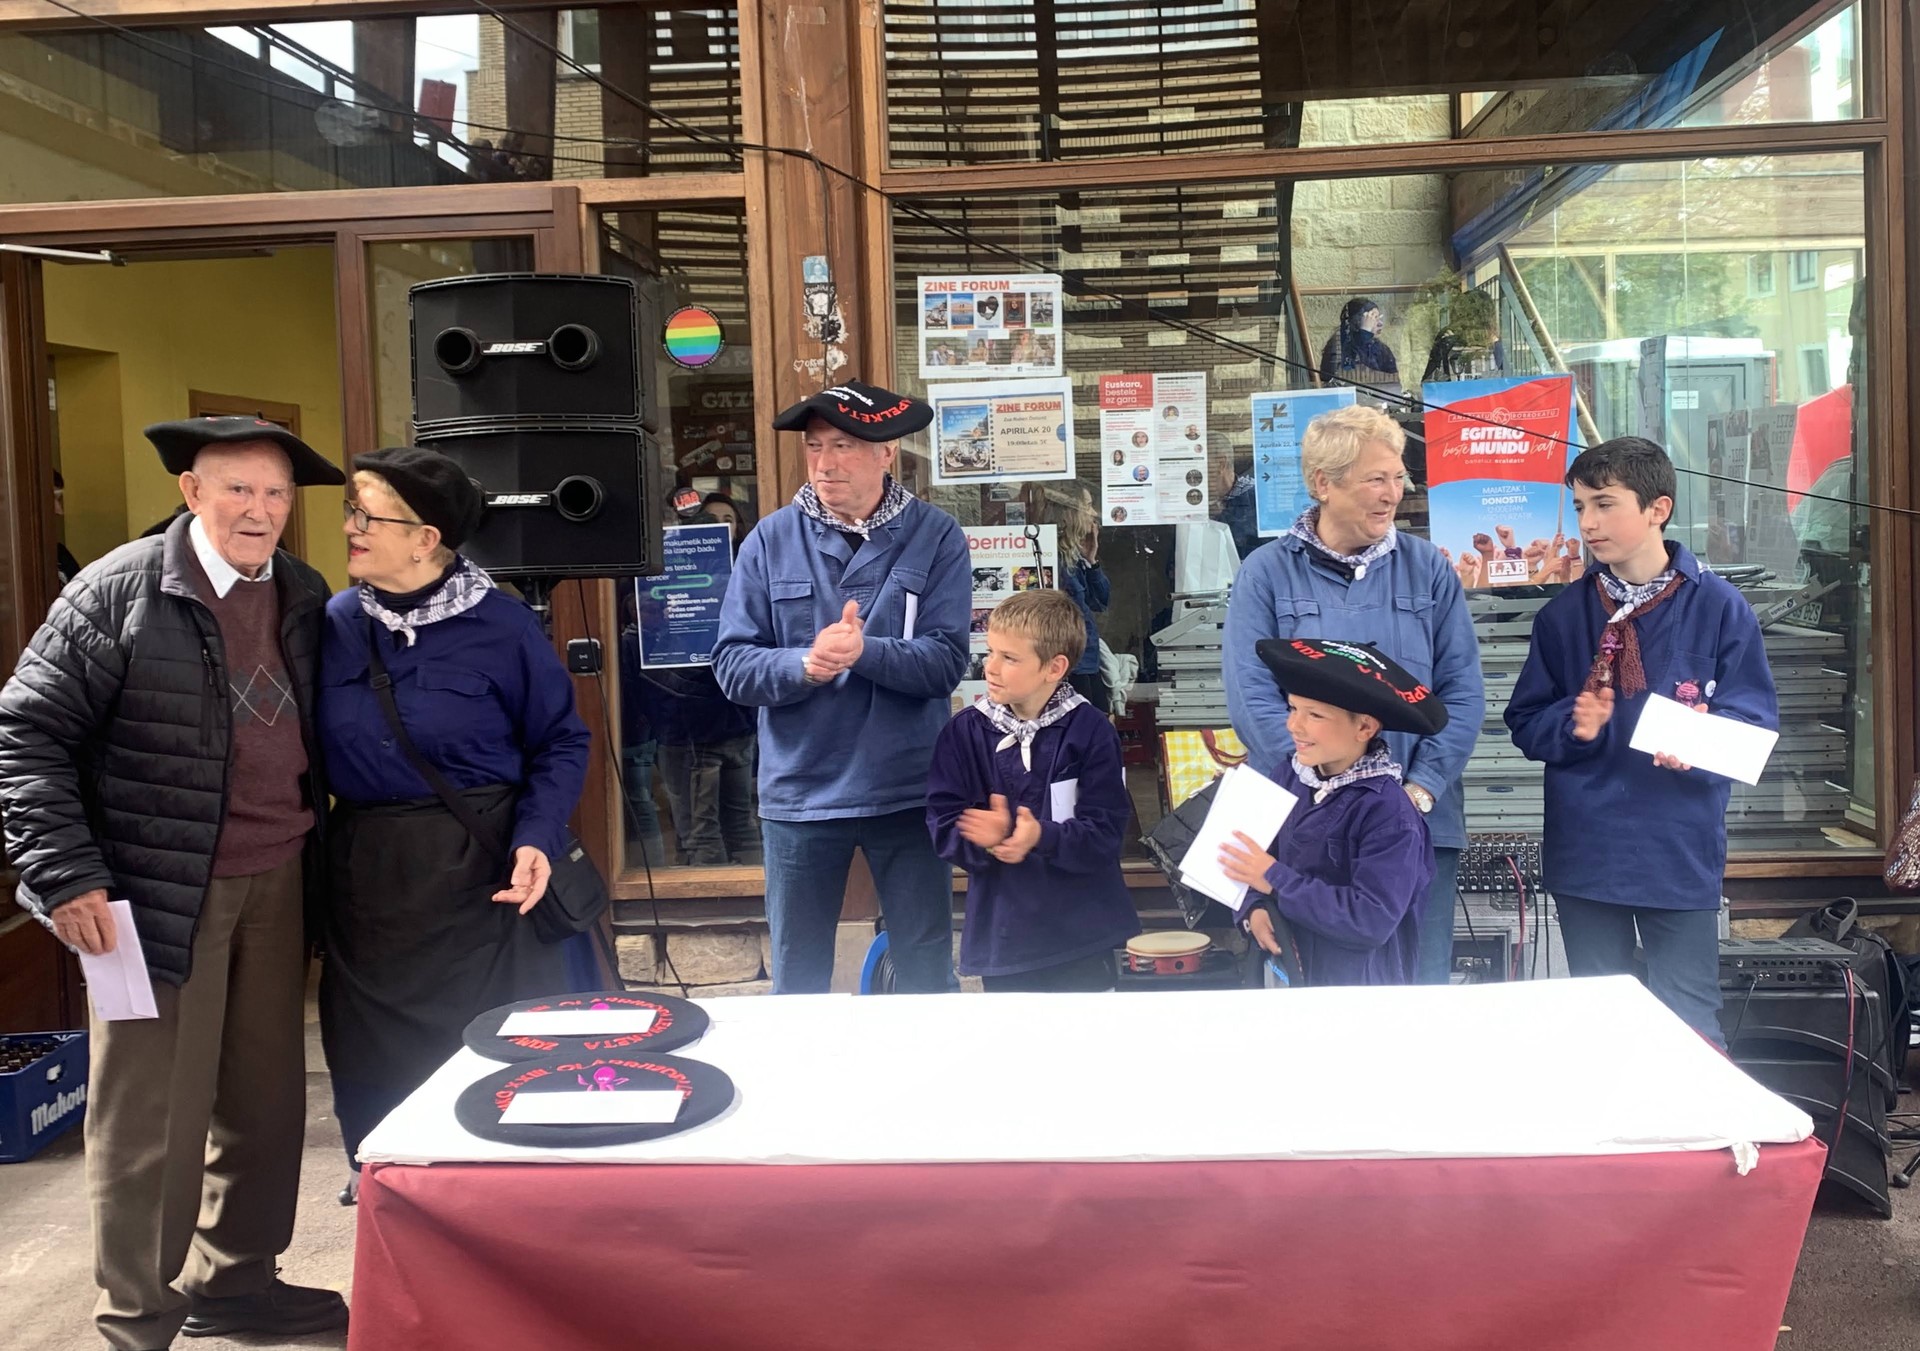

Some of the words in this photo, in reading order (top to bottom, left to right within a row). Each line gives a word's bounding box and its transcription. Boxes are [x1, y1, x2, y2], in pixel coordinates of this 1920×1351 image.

[924, 281, 957, 291] ZINE
[961, 280, 1010, 291] FORUM
[483, 343, 543, 353] BOSE
[996, 403, 1021, 412] ZINE
[1024, 401, 1061, 411] FORUM
[1001, 427, 1039, 435] APIRILAK
[1461, 426, 1525, 441] EGITEKO
[1470, 441, 1530, 455] MUNDU
[1482, 486, 1520, 494] MAIATZAK
[488, 494, 548, 504] BOSE
[1482, 496, 1528, 505] DONOSTIA
[967, 533, 1026, 550] berria
[1490, 562, 1526, 576] LAB
[31, 1083, 86, 1135] Mahou
